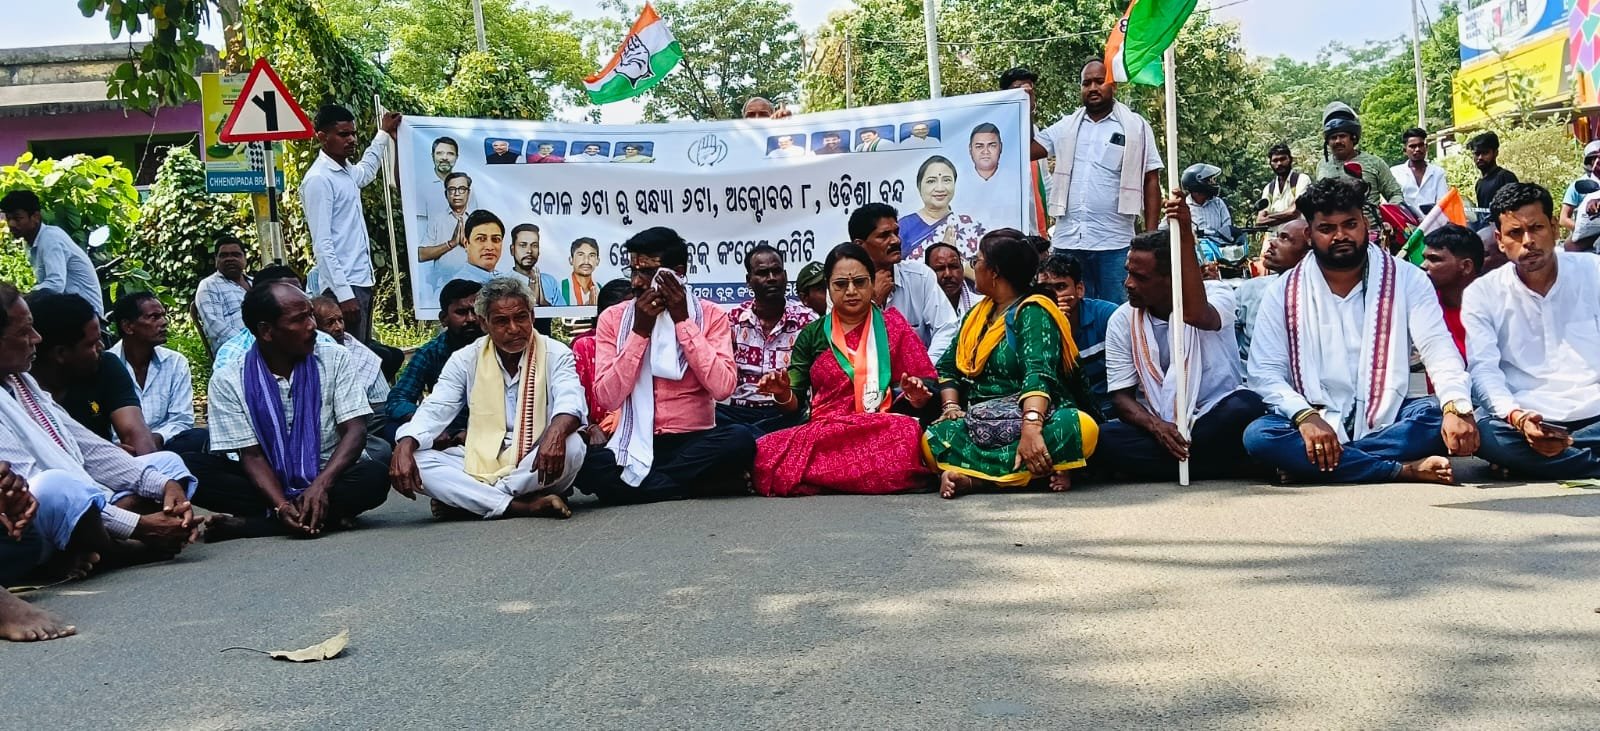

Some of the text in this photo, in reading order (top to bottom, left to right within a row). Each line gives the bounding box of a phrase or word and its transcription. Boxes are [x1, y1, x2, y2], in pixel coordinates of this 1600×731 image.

[209, 176, 281, 187] CHHENDIPADA BRAH
[615, 189, 633, 225] ରୁ
